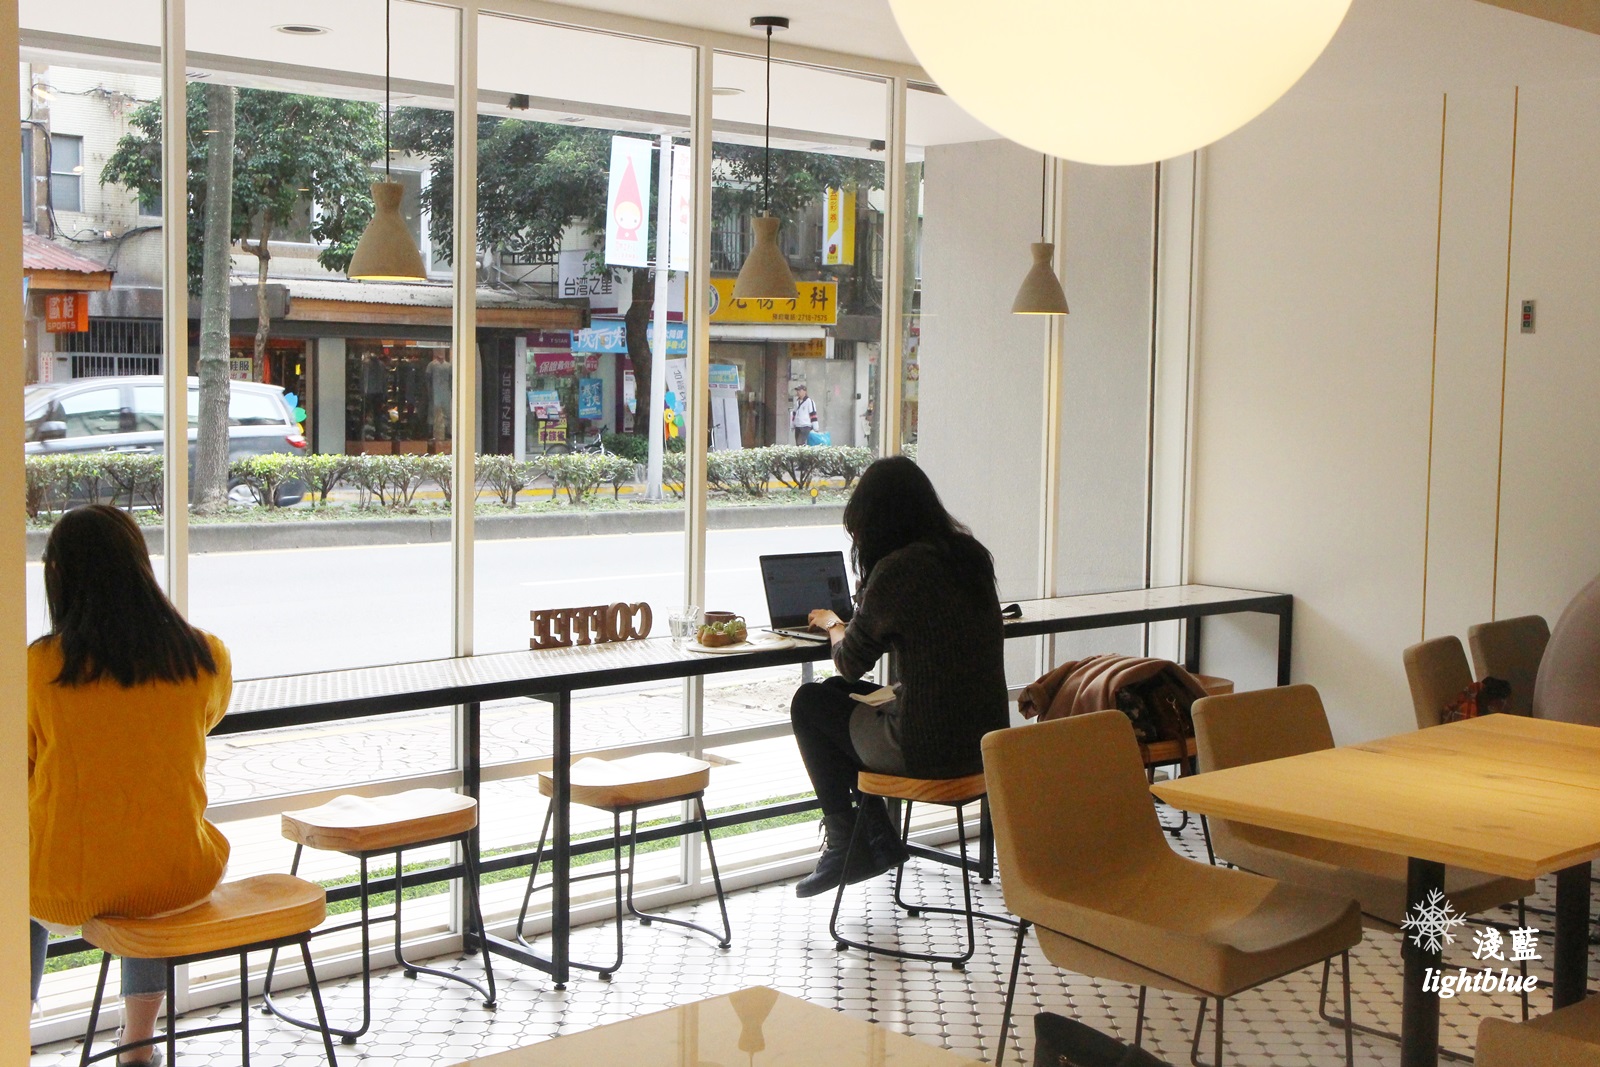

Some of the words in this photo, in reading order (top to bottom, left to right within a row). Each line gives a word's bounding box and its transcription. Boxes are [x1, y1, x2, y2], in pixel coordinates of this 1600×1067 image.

[565, 277, 612, 295] 台灣之星
[48, 321, 76, 330] SPORTS
[502, 371, 512, 436] 台灣之星
